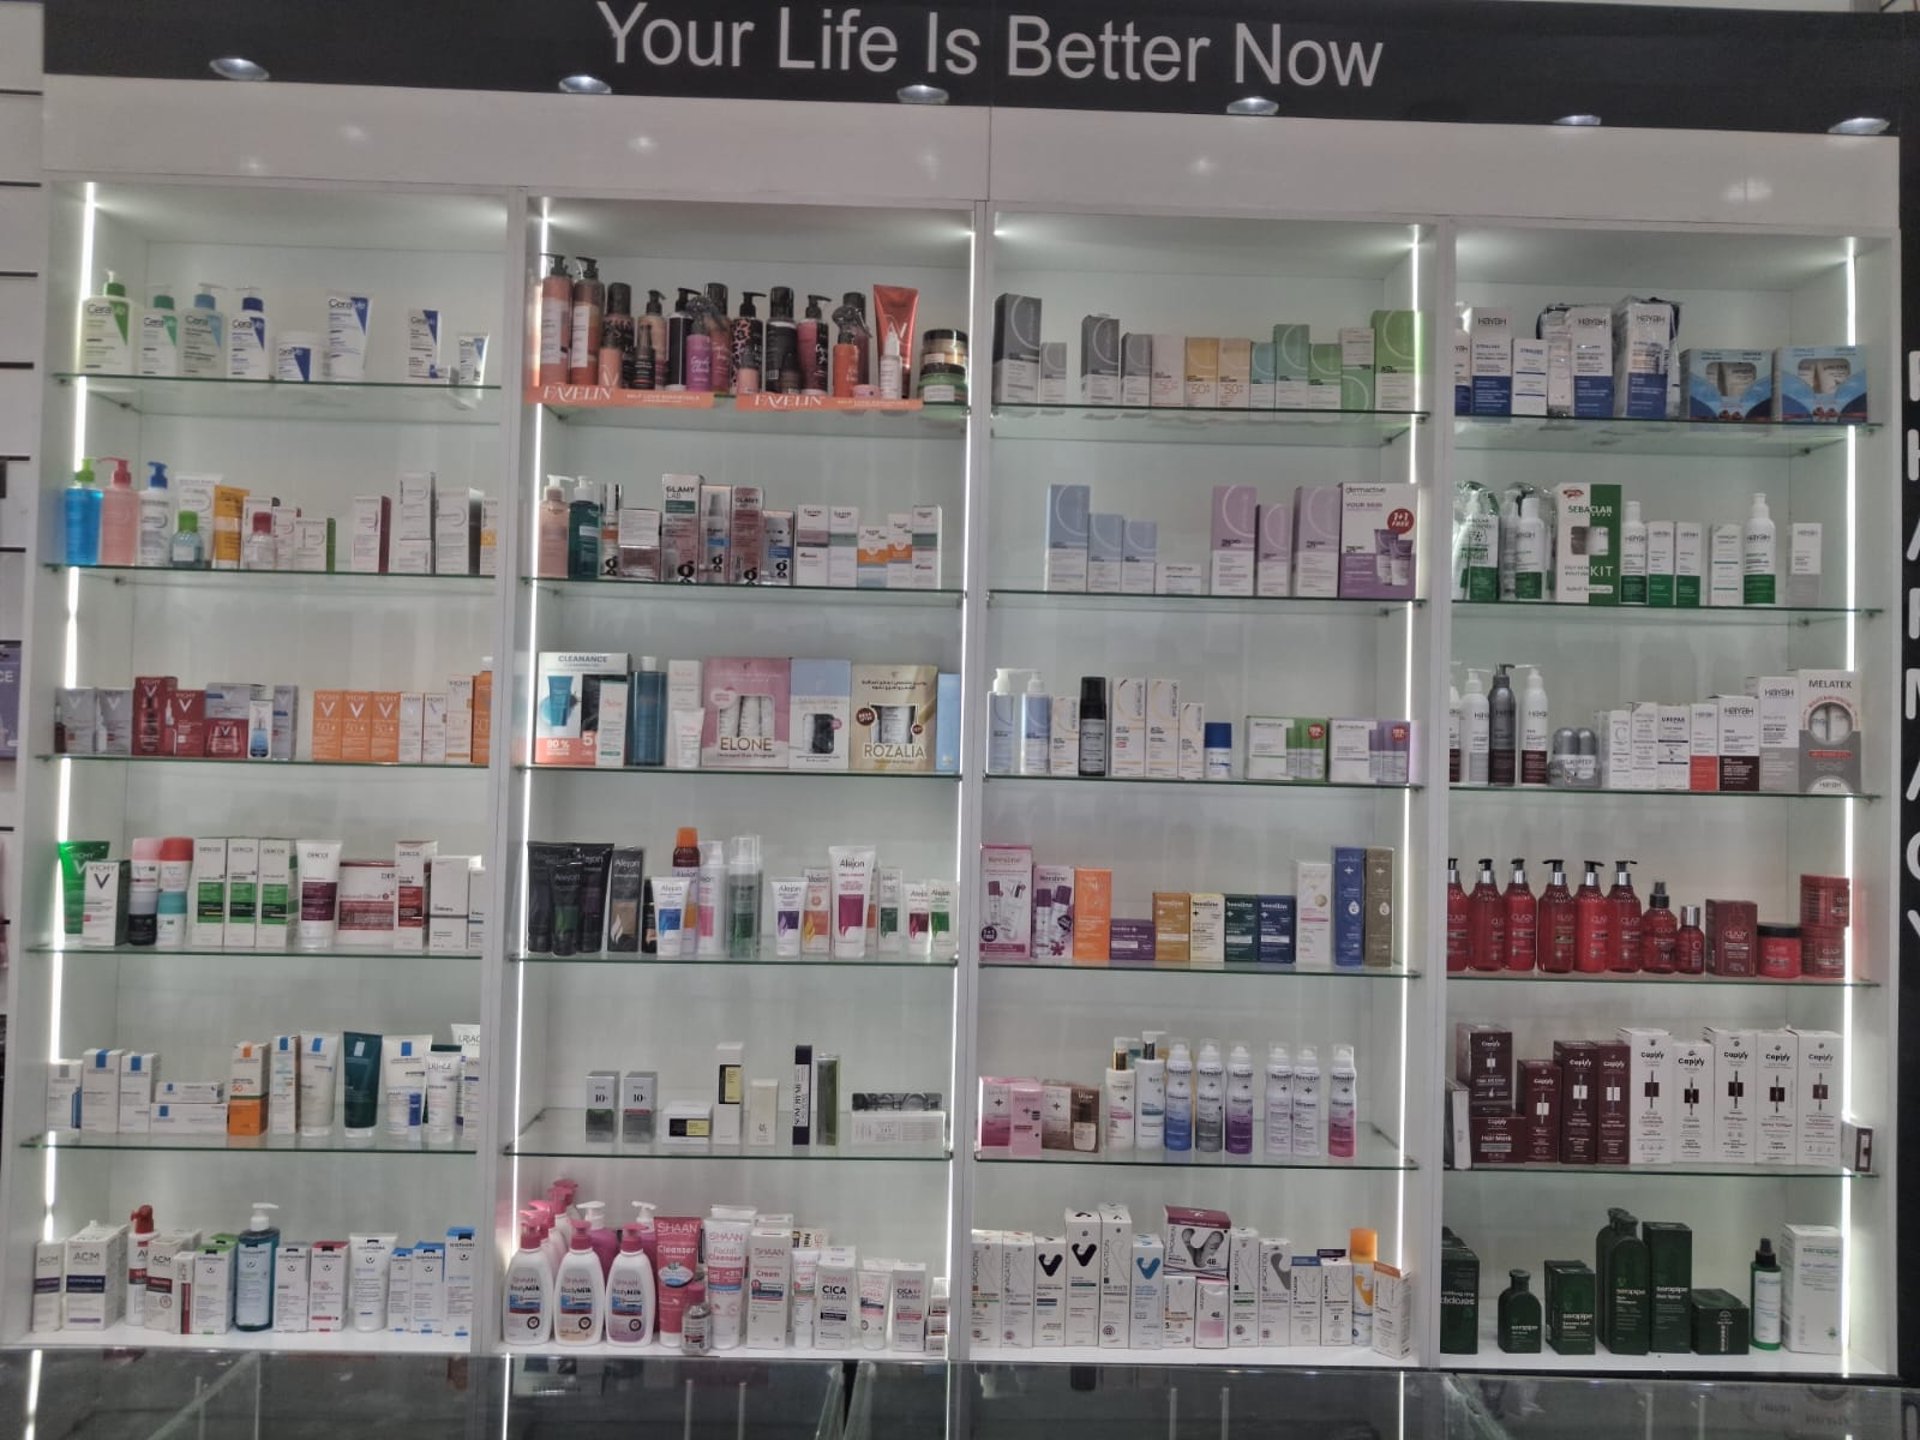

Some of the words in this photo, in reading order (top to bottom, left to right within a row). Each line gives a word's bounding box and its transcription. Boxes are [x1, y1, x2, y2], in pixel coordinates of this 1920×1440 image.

[598, 1, 755, 67] Your
[779, 7, 898, 71] Life
[925, 12, 981, 74] Is
[1009, 15, 1211, 83] Better
[1235, 22, 1384, 87] Now
[1568, 505, 1612, 513] SEBACLAR
[1591, 566, 1613, 577] KIT
[1808, 680, 1852, 689] MELATEX
[180, 699, 192, 712] V
[321, 702, 335, 717] V
[351, 703, 364, 719] V
[379, 703, 393, 718] V
[720, 737, 772, 751] ELONE
[864, 743, 925, 758] ROZALIA
[94, 873, 110, 889] V
[658, 1223, 697, 1233] SHAAN
[658, 1246, 694, 1254] Cleanser
[73, 1252, 99, 1261] ACM
[152, 1256, 171, 1264] ACM
[822, 1286, 846, 1295] CICA
